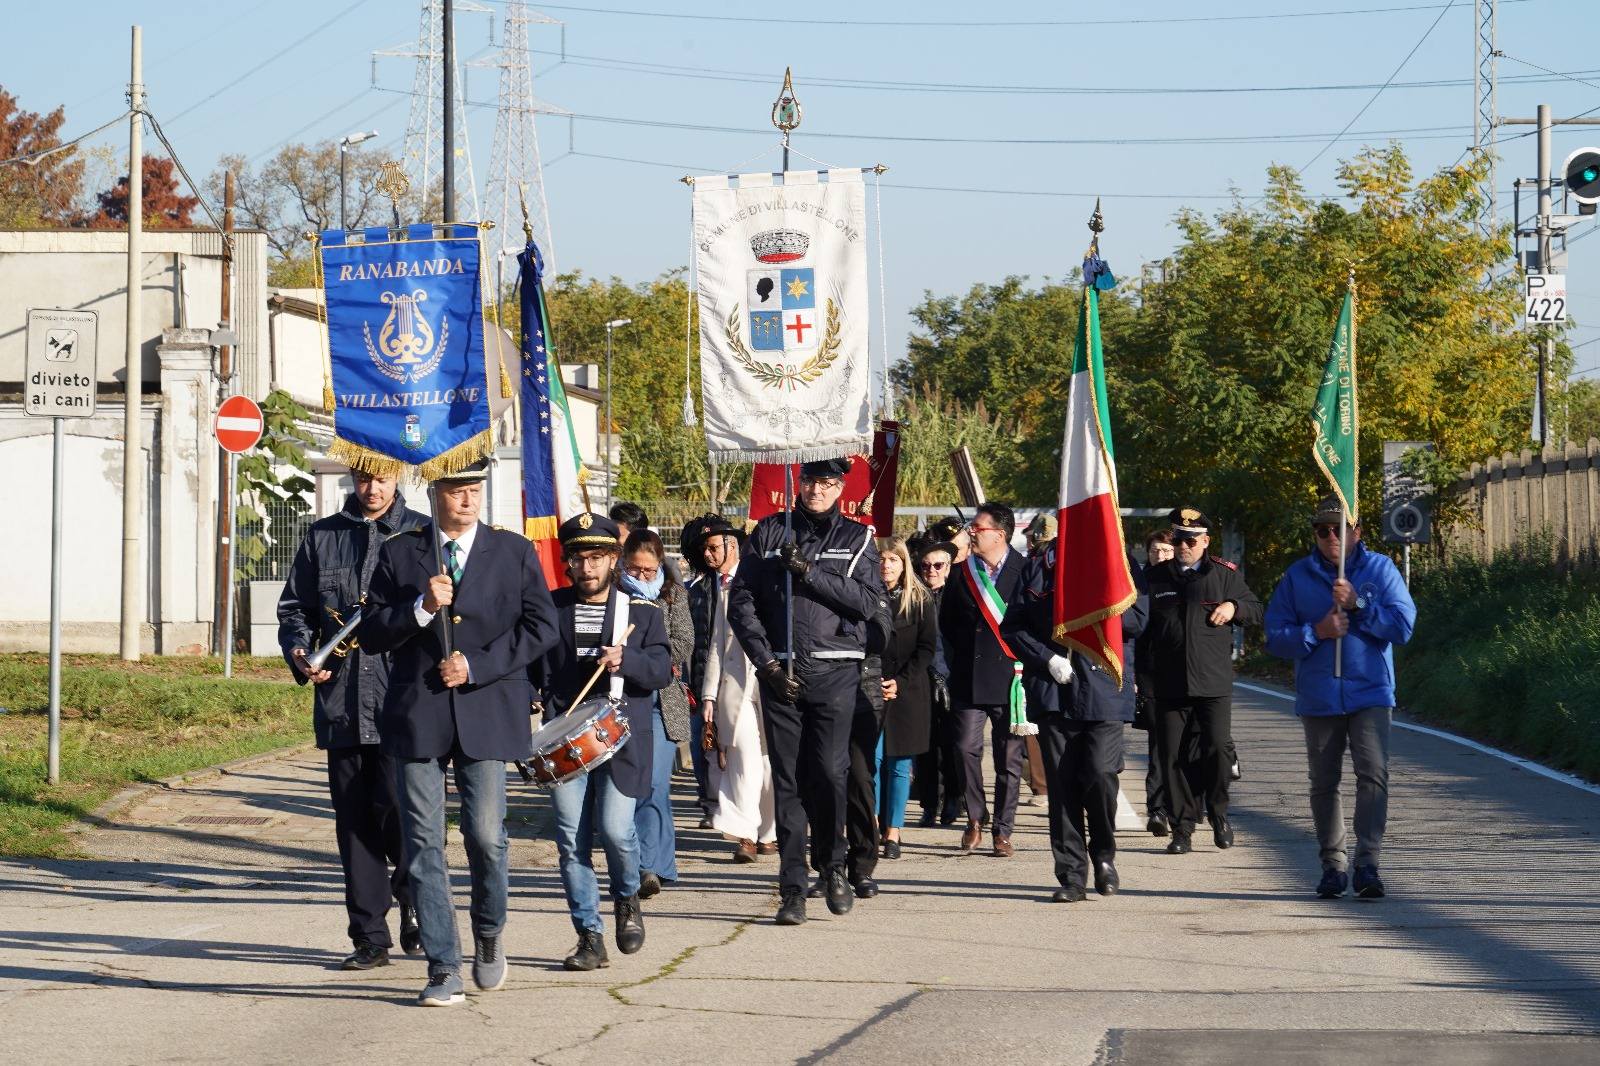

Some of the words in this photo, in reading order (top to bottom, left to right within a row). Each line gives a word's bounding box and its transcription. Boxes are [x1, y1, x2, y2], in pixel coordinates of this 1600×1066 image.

[748, 203, 762, 216] DI
[339, 258, 465, 281] RANABANDA
[1527, 276, 1546, 296] P
[1528, 298, 1565, 321] 422
[31, 371, 90, 387] divieto
[32, 392, 46, 406] ai
[55, 393, 89, 407] cani
[340, 387, 480, 408] VILLASTELLONE
[1340, 392, 1352, 436] TORINO
